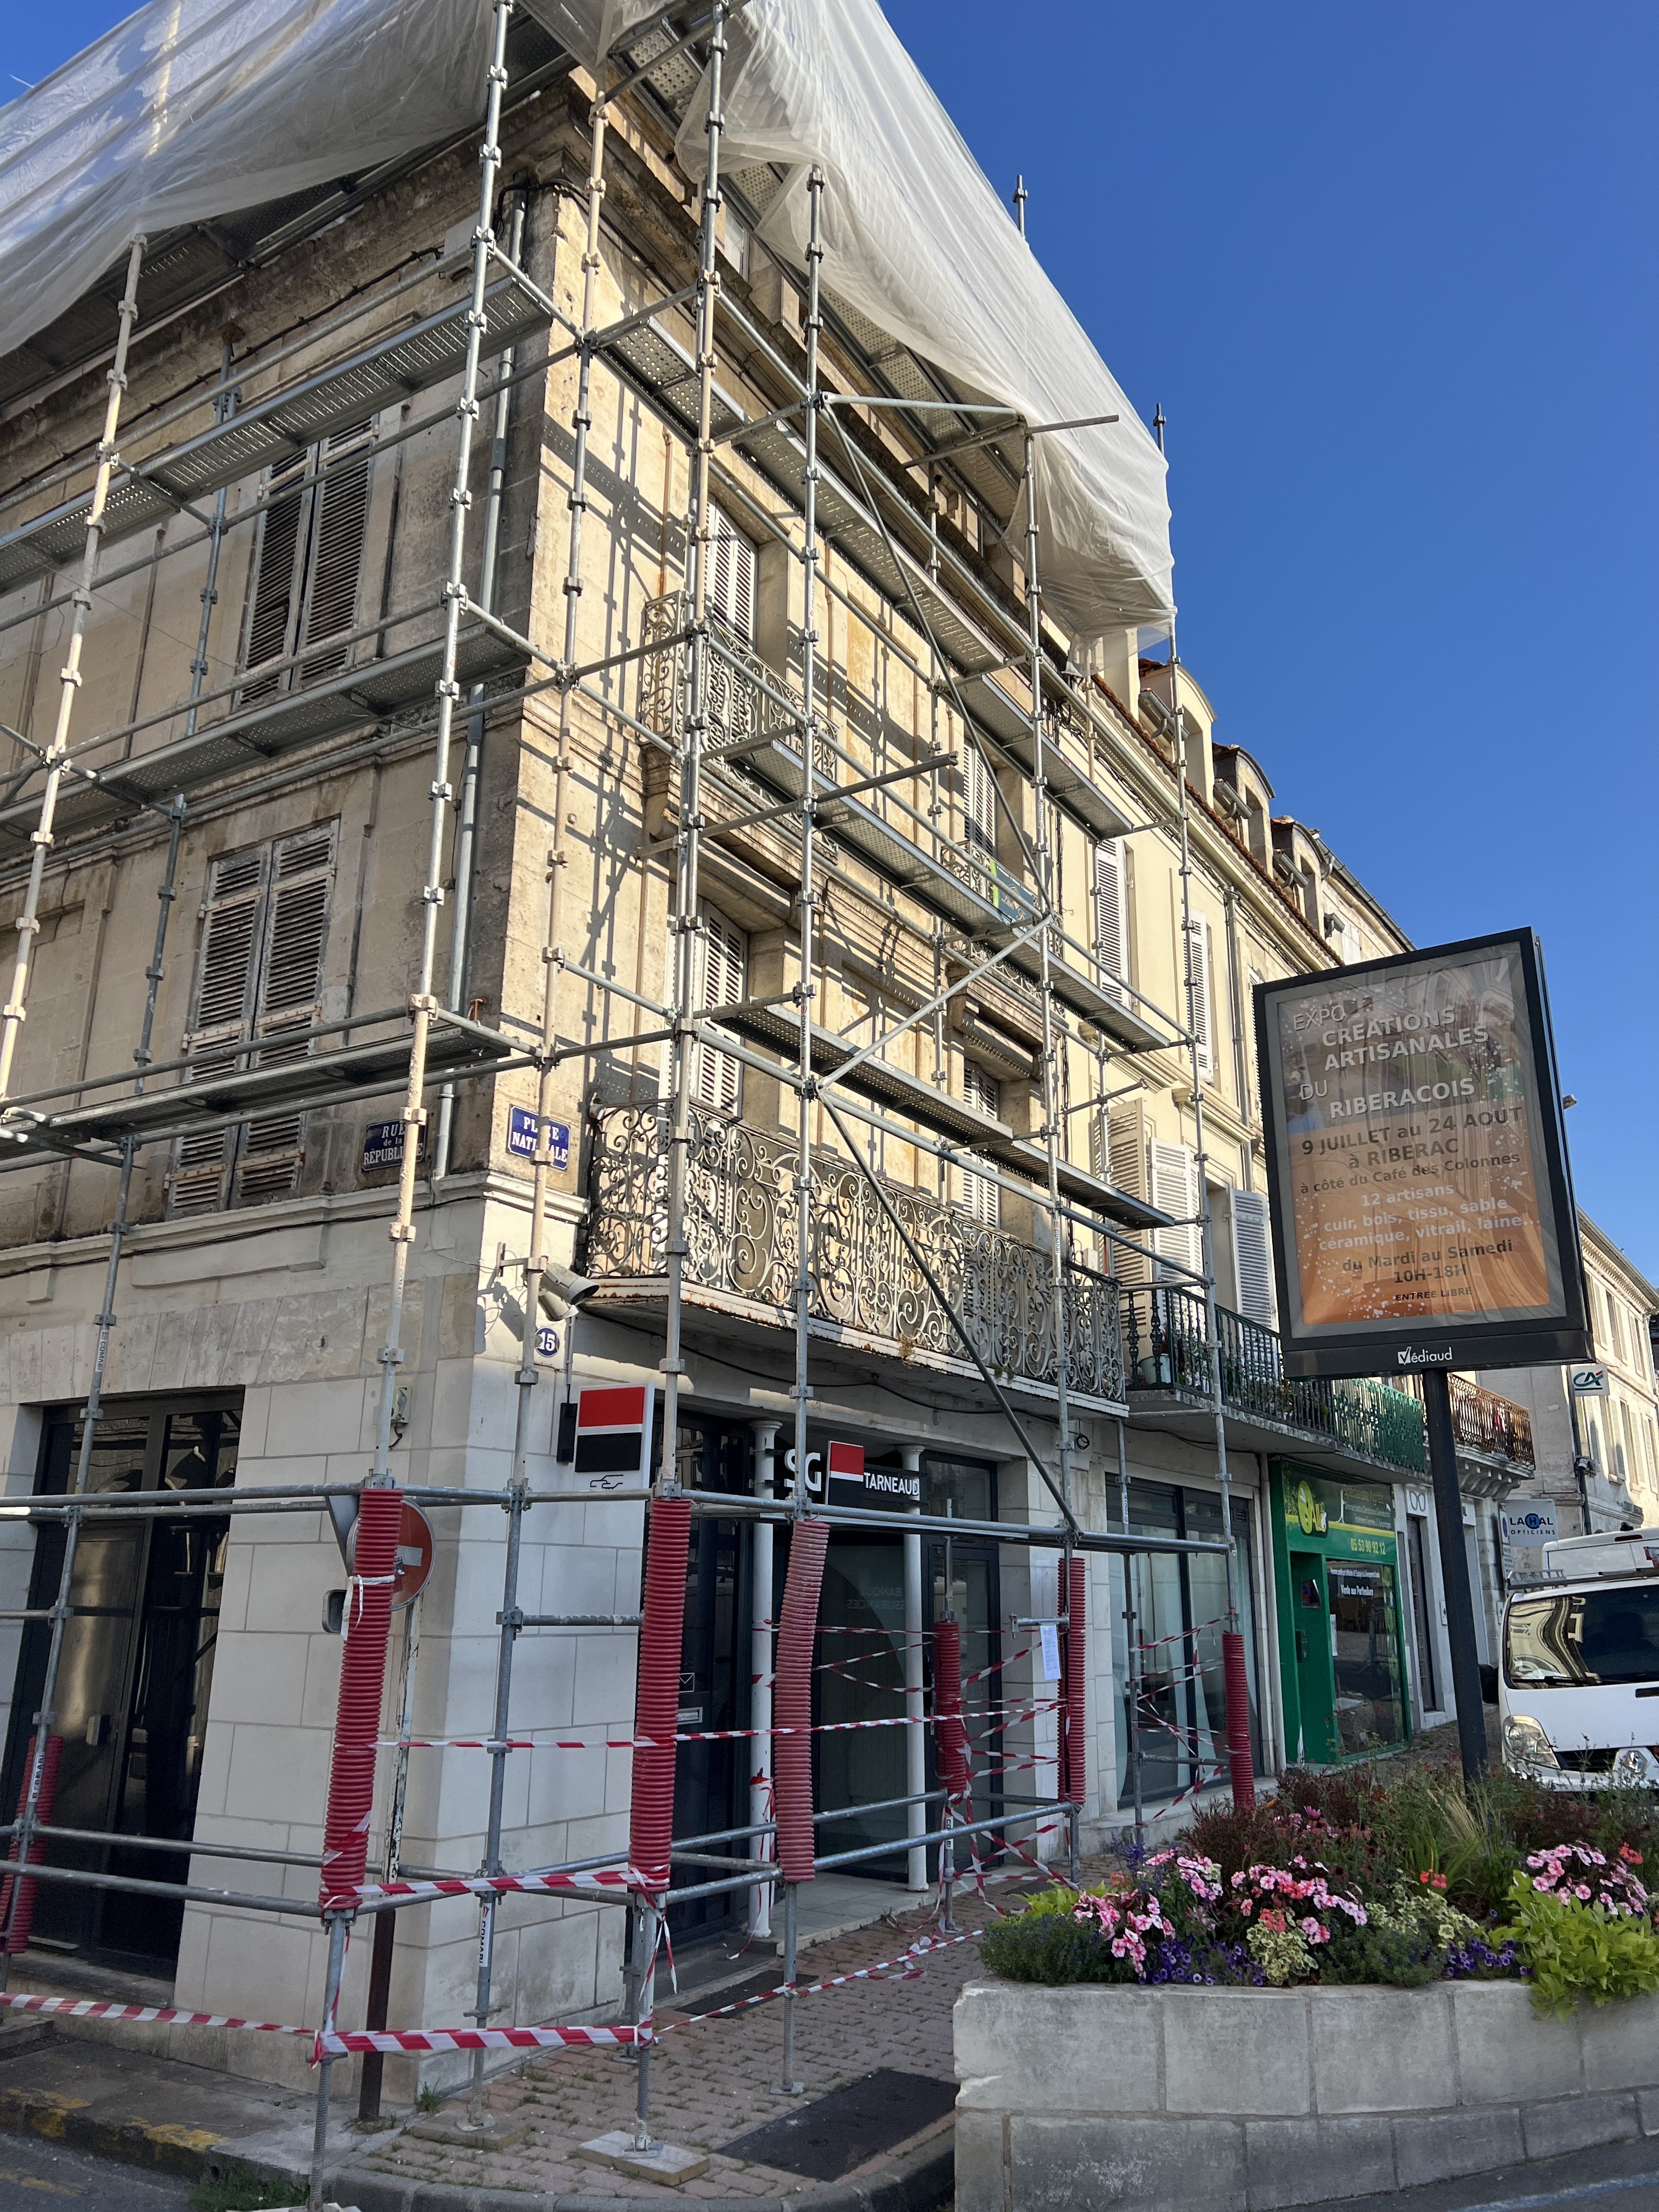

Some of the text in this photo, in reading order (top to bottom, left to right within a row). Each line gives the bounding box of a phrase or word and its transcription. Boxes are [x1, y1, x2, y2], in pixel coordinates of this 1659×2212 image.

[1294, 1005, 1346, 1031] EXPO
[1322, 1007, 1455, 1047] CREATIONS
[1325, 1026, 1489, 1070] ARTISANALES
[1300, 1080, 1328, 1100] DU
[1330, 1077, 1475, 1119] RIBERACOIS
[382, 1124, 405, 1138] RUE
[523, 1116, 559, 1140] PLE
[1302, 1107, 1522, 1155] 9 JUILLET au 24 AOUT
[363, 1143, 423, 1165] RÉPUBLIE
[512, 1132, 568, 1162] NATIALE
[1348, 1138, 1458, 1169] à RIBERAC
[1301, 1154, 1520, 1194] à côté du Café des Colonnes
[1362, 1184, 1454, 1206] 12 artisans
[1324, 1198, 1508, 1232] cuir, bois, tissu, sable
[1319, 1215, 1540, 1251] céramique, vitrail, laine...
[1343, 1239, 1513, 1271] du Mardi au Samedi
[1394, 1264, 1466, 1283] 10H-18H
[1396, 1287, 1471, 1301] ENTREE LIBRE
[536, 1332, 555, 1351] 15
[1398, 1347, 1452, 1365] Védiaud
[785, 1449, 821, 1491] SG
[864, 1472, 919, 1496] TARNEAUD
[1350, 1537, 1386, 1555] 05 53 90 92 12
